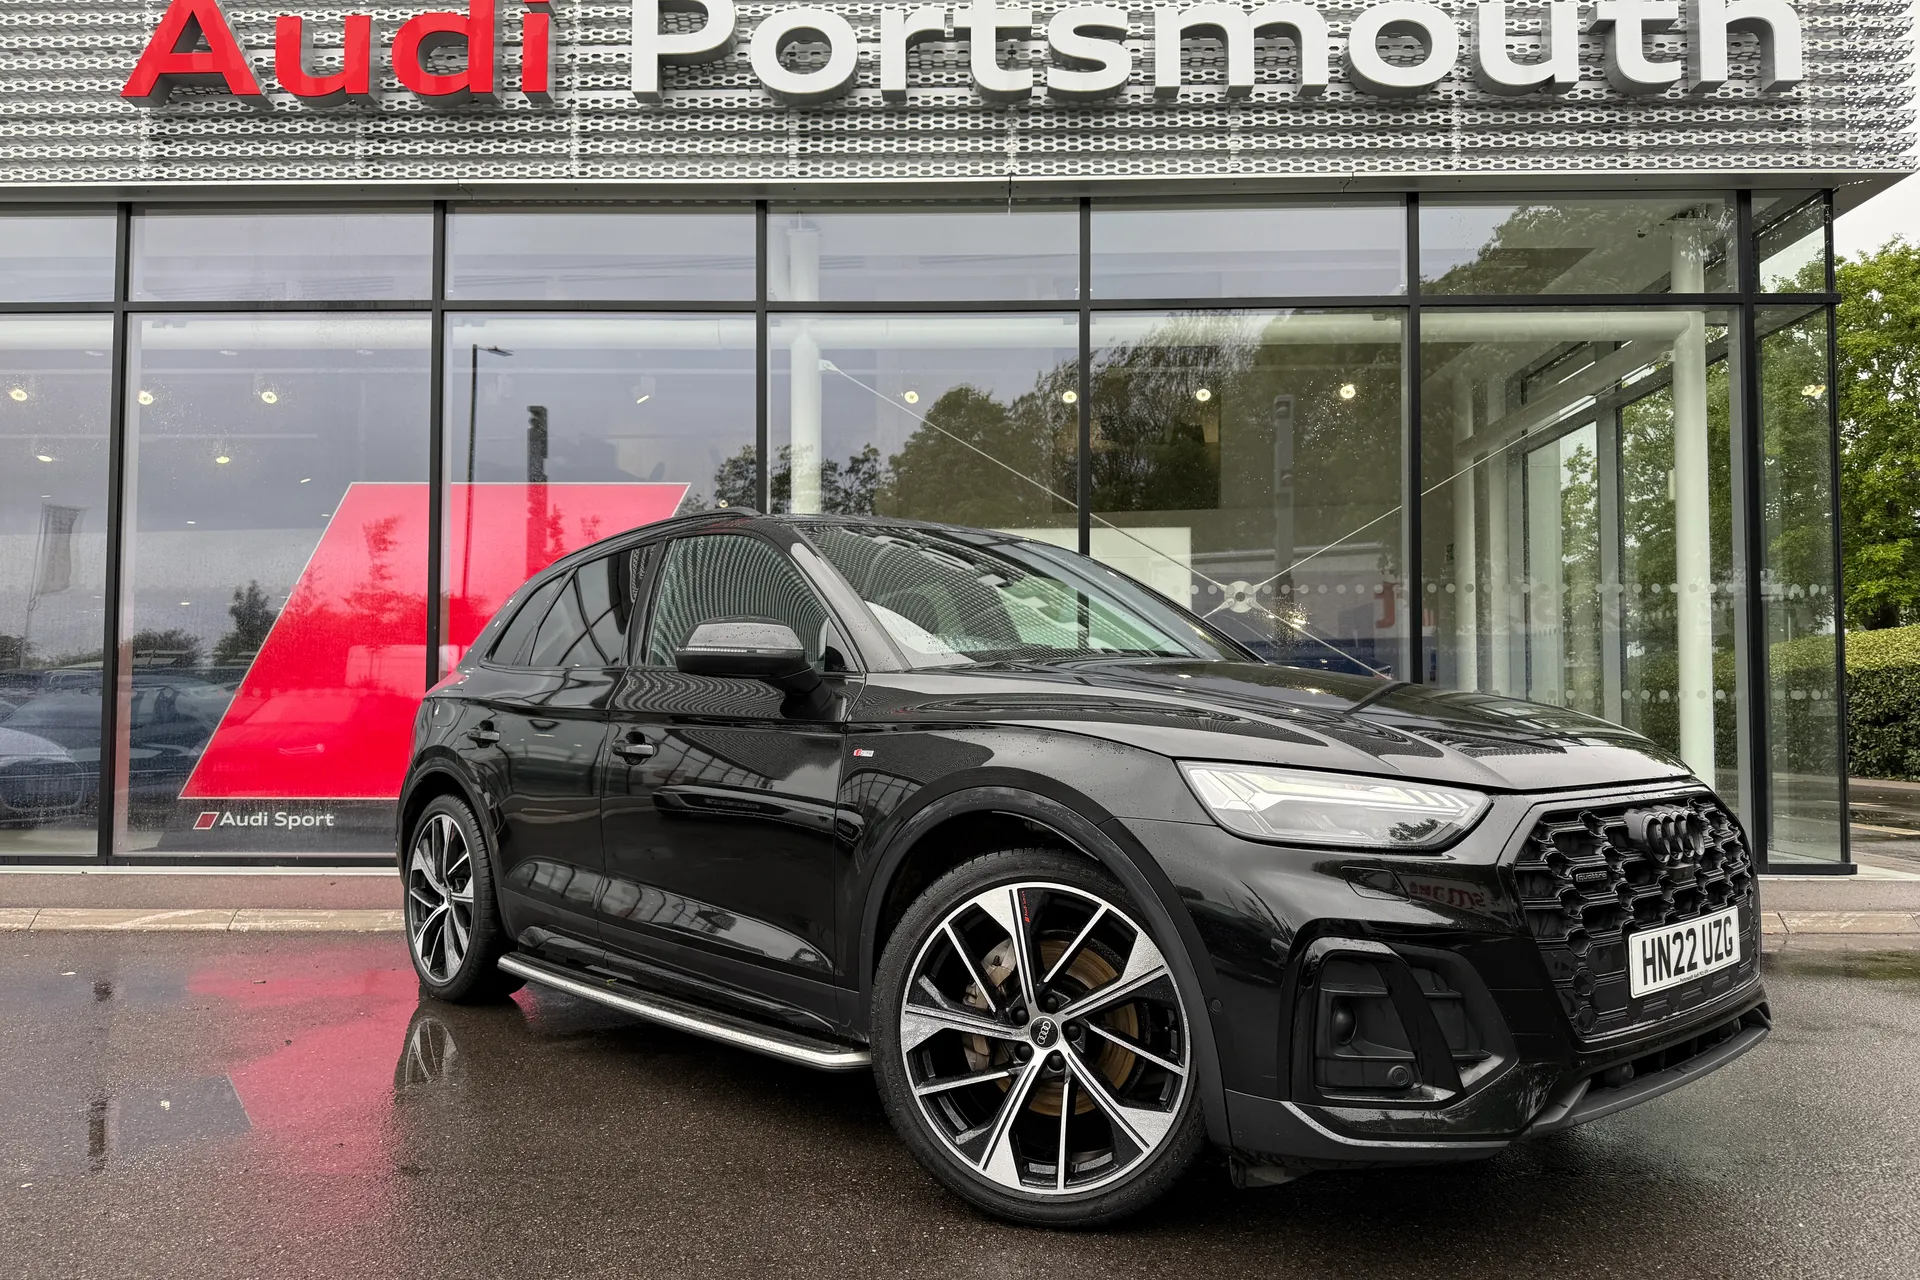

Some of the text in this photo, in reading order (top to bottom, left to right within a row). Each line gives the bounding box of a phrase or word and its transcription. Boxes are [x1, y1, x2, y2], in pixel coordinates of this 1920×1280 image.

[120, 0, 1803, 99] Audi Portsmouth
[219, 811, 335, 830] Audi Sport
[1577, 871, 1607, 881] quattro
[1641, 915, 1733, 986] HN22 UZG
